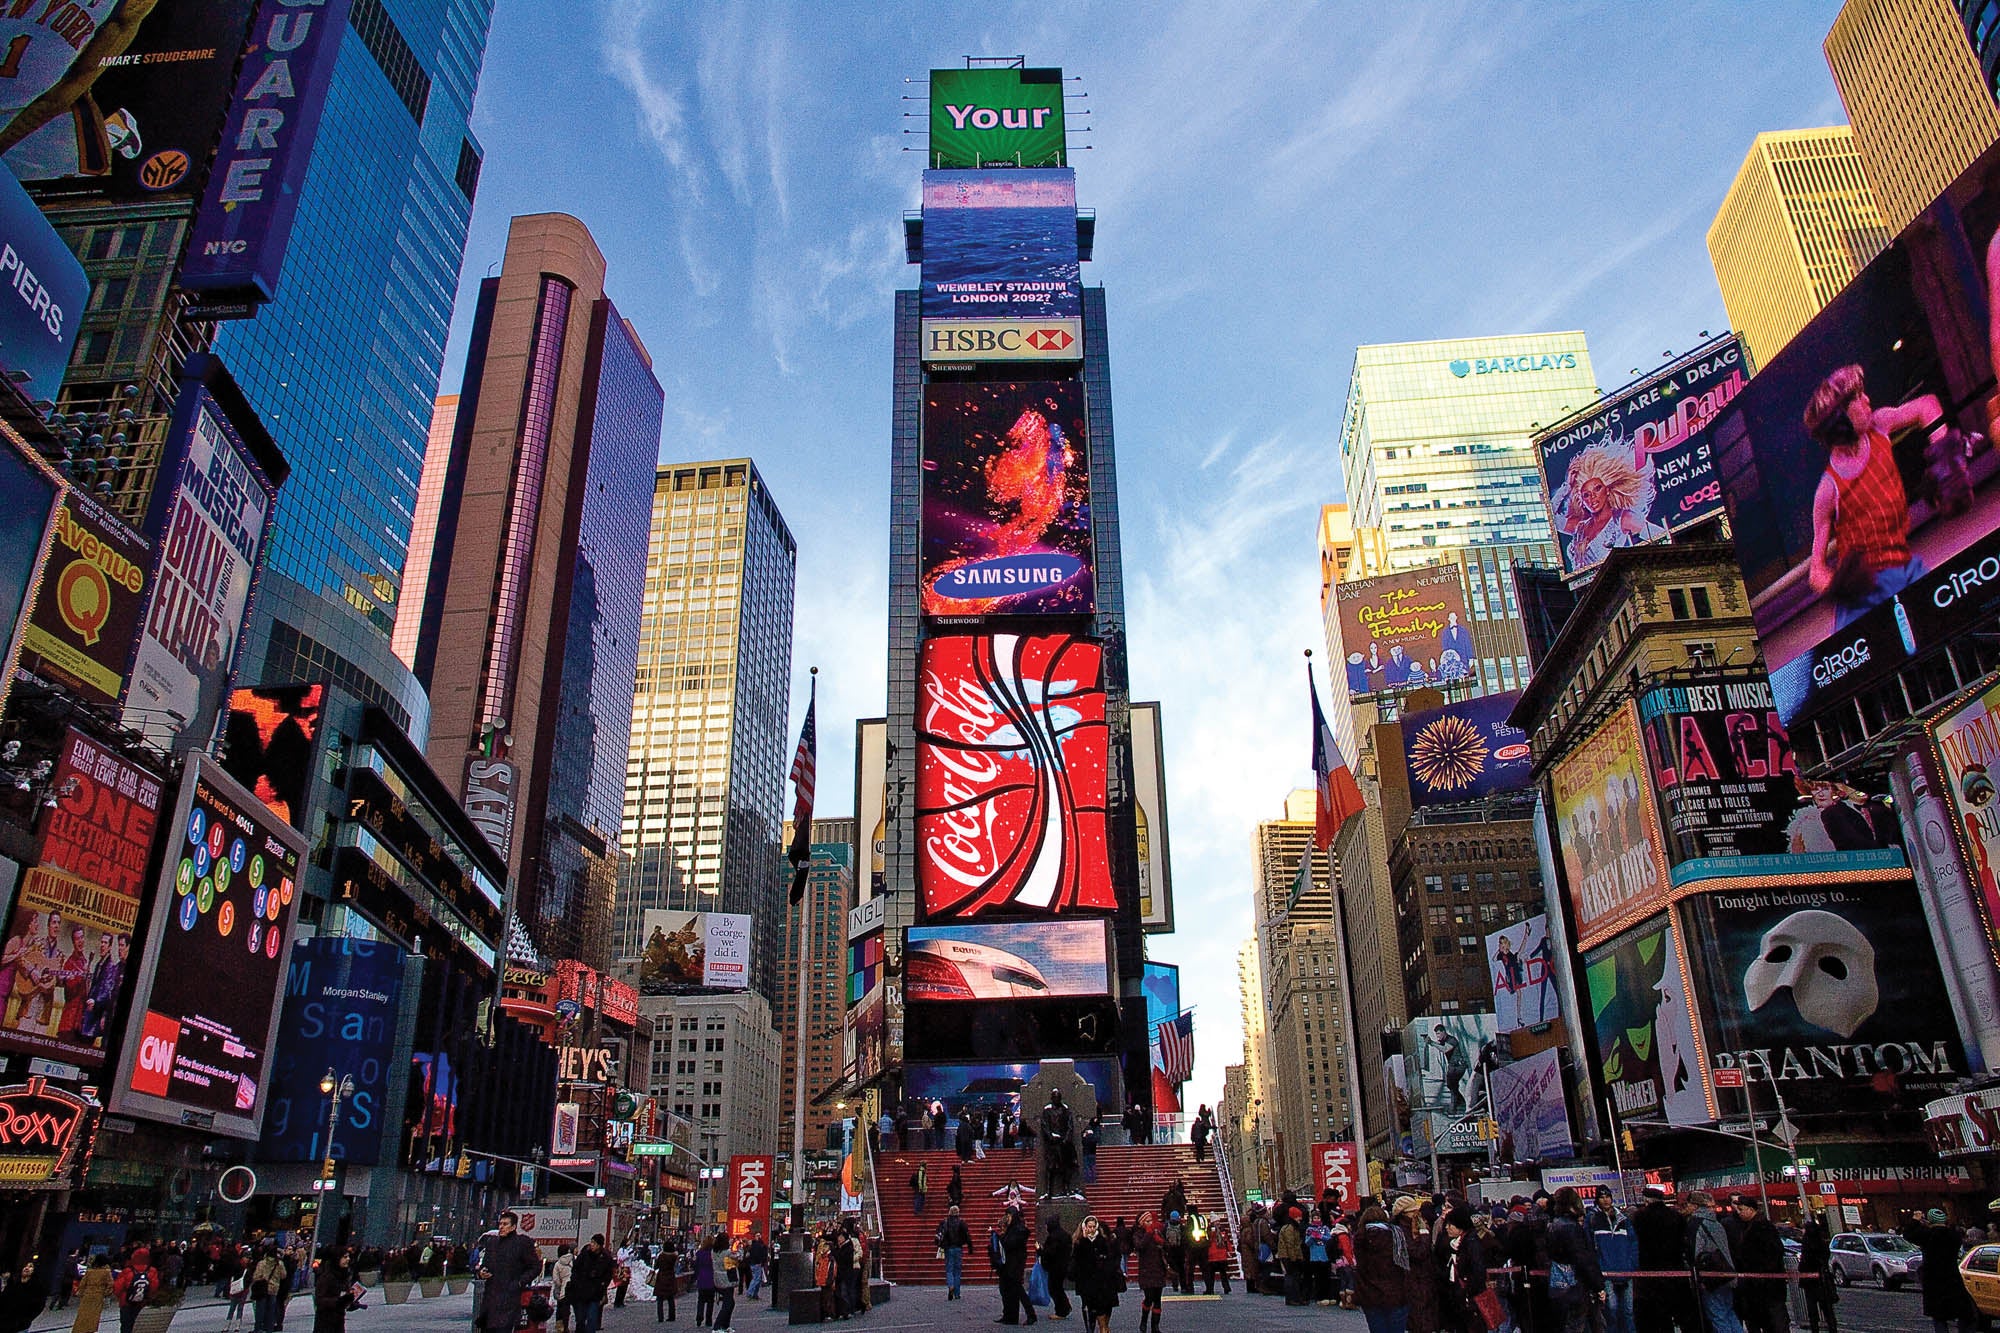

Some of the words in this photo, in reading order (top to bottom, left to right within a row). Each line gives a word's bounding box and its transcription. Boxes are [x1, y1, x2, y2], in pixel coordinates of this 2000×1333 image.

[98, 54, 142, 67] AMAR'E
[143, 48, 216, 64] STOUDEMIRE
[219, 0, 325, 202] UARE
[944, 104, 1051, 131] Your
[203, 239, 248, 256] NYC
[937, 283, 1003, 293] WEMBLEY
[1006, 282, 1066, 291] STADIUM
[952, 294, 1008, 303] LONDON
[1012, 293, 1051, 303] 2092?
[929, 329, 1022, 352] HSBC
[1475, 352, 1577, 375] BARCLAYS
[1544, 408, 1621, 458] MONDAYS
[1628, 388, 1661, 416] ARE
[1668, 380, 1681, 395] A
[1686, 348, 1739, 384] DRAG
[1656, 453, 1691, 480] NEW
[1660, 473, 1688, 492] MON
[1690, 462, 1712, 480] JAN
[207, 453, 249, 521] BEST
[66, 484, 104, 517] ROADWAY'S
[183, 457, 254, 568] MUSICAL
[80, 502, 99, 522] BEST
[99, 518, 130, 546] MUSICAL
[55, 505, 143, 593] Avenue
[166, 495, 228, 608] BILLY
[218, 552, 236, 600] MUSICAL
[953, 566, 1064, 585] SAMSUNG
[1416, 573, 1459, 587] NEUWIRTH
[1438, 565, 1458, 575] BEBE
[1933, 552, 2000, 609] CÎRO
[1338, 580, 1375, 594] NATHAN
[1339, 590, 1360, 601] LANE
[1379, 588, 1420, 604] The
[57, 557, 111, 646] Q
[1358, 601, 1446, 624] Addams
[937, 617, 980, 625] SHERWOOD
[1367, 617, 1444, 639] Family
[1812, 638, 1869, 682] CÎROC
[1816, 671, 1833, 690] THE
[1832, 663, 1850, 682] NEW
[1686, 685, 1723, 713] BEST
[1725, 682, 1777, 710] MUSIC
[73, 739, 97, 765] ELVIS
[1647, 716, 1720, 792] LA
[69, 756, 93, 776] PRESLEY
[94, 764, 118, 788] LEWIS
[119, 766, 139, 789] CARL
[925, 668, 1000, 887] Coca-Cola
[1560, 764, 1594, 804] GOES
[61, 772, 155, 847] ONE
[138, 789, 159, 811] CASH
[1688, 798, 1706, 811] CAGE
[1708, 797, 1723, 809] AUX
[1724, 796, 1751, 808] FOLLES
[49, 807, 147, 873] ELECTRIFYING
[501, 801, 515, 863] Chocolate
[41, 833, 142, 898] NIGHT
[1580, 857, 1621, 925] JERSEY
[1620, 838, 1659, 900] BOYS
[25, 894, 64, 912] INSPIRED
[64, 904, 77, 915] BY
[76, 908, 93, 921] THE
[109, 919, 134, 933] STORY
[1714, 893, 1769, 912] Tonight
[1773, 889, 1827, 910] belongs
[710, 926, 746, 940] George,
[723, 917, 735, 930] By
[714, 947, 730, 958] did
[730, 949, 740, 958] it.
[722, 939, 735, 947] we
[952, 946, 982, 955] EQUUS
[710, 963, 742, 972] LEADERSHIP
[322, 986, 359, 999] Morgan
[358, 988, 389, 1004] Stanley
[139, 1035, 175, 1076] CNN
[1715, 1040, 1957, 1083] PHANTOM
[1611, 1078, 1657, 1113] WICKED
[1450, 1122, 1479, 1134] SOUT
[0, 1163, 48, 1176] ICATESSEN
[1323, 1148, 1352, 1203] tkts
[739, 1160, 765, 1213] tkts
[542, 1217, 566, 1225] DOING
